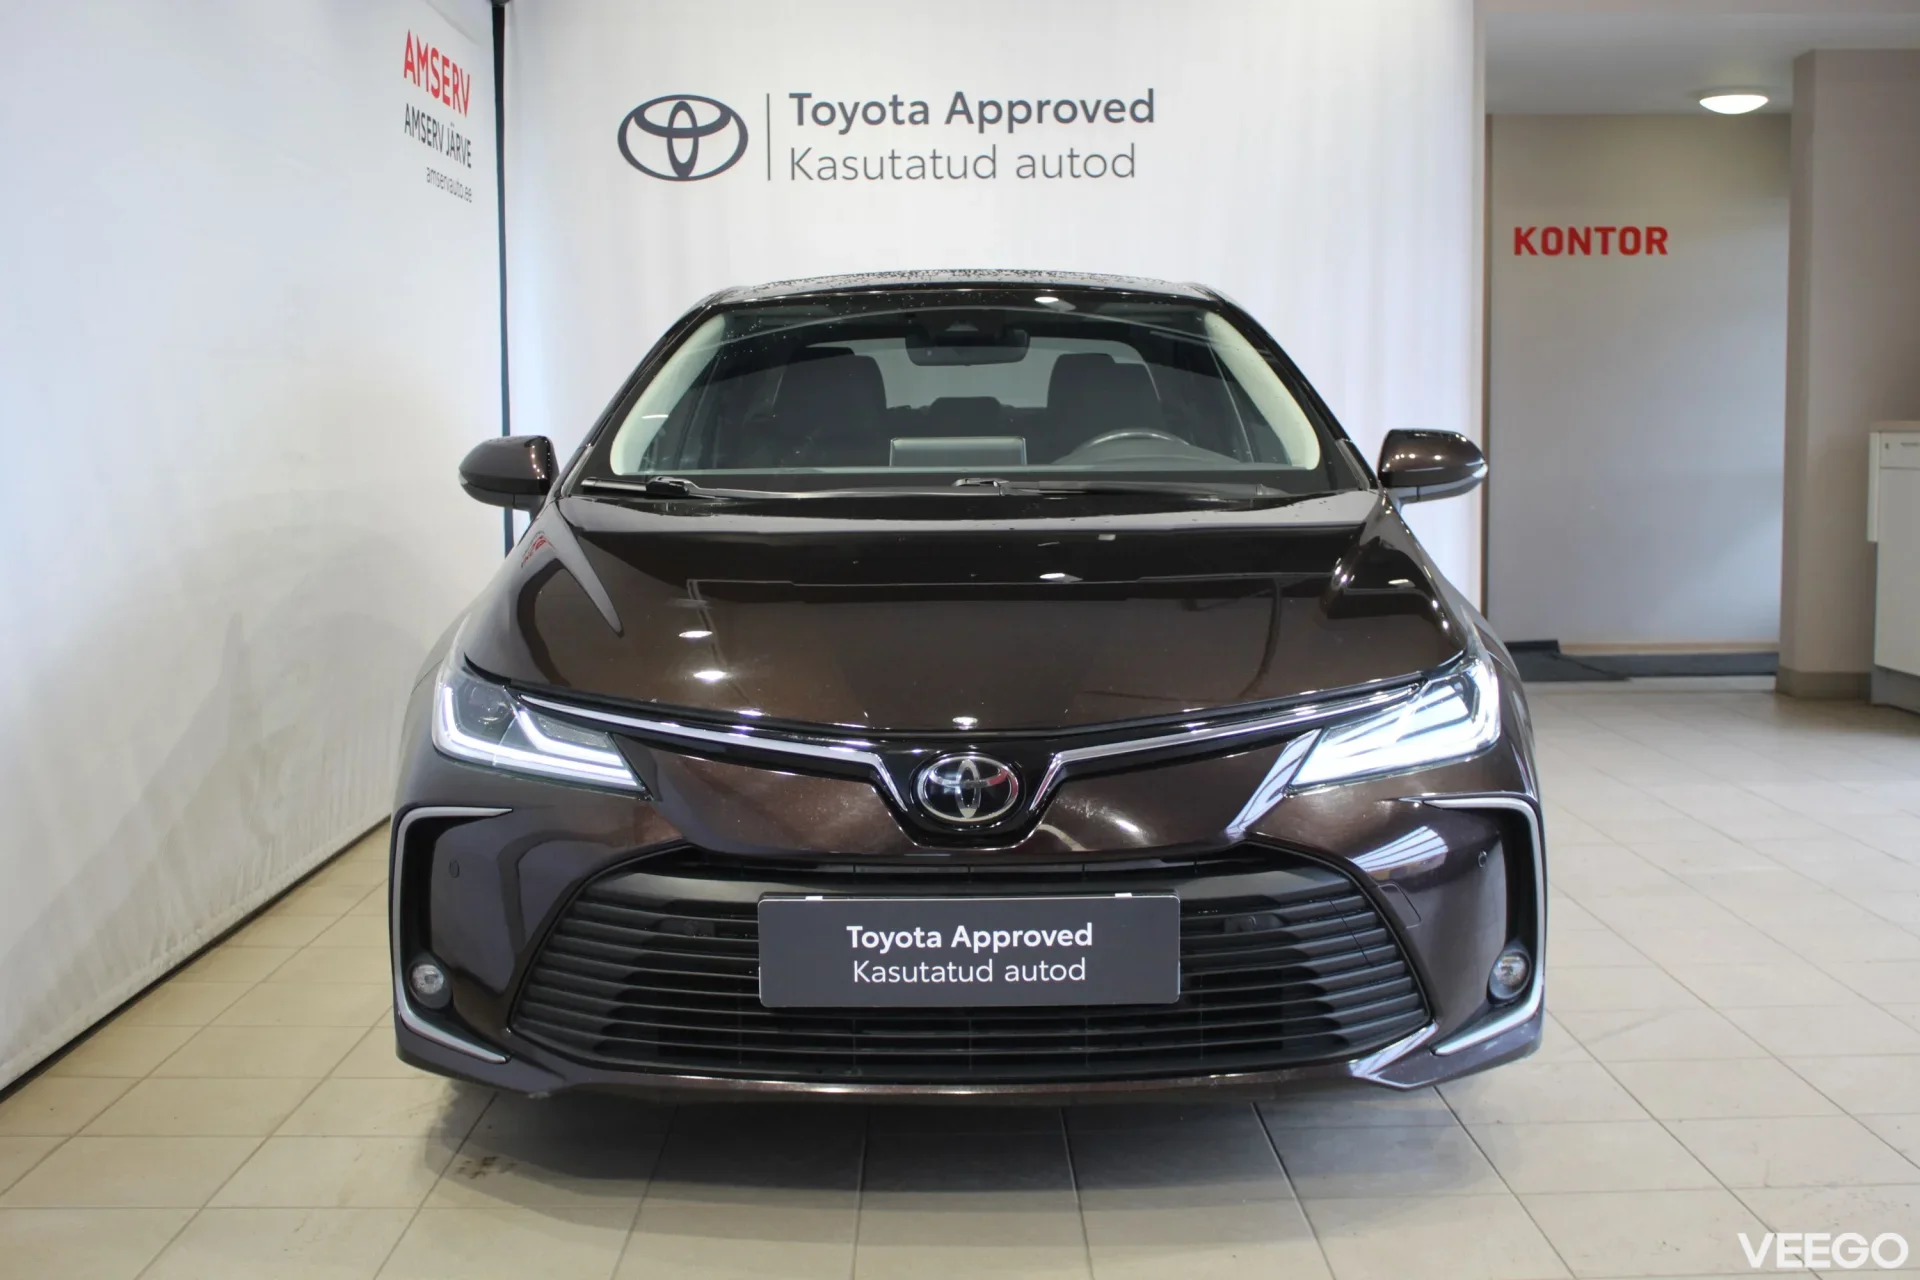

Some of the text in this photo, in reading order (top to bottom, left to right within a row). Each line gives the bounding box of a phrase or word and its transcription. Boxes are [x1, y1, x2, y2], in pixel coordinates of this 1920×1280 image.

[404, 29, 470, 118] AMSERV
[789, 88, 1156, 135] Toyota Approved
[404, 103, 472, 169] AMSERV JÄRVE
[790, 143, 1136, 181] Kasutatud autod
[426, 166, 473, 203] amservauto.ee
[1513, 226, 1669, 256] KONTOR
[846, 922, 1093, 955] Toyota Approved
[853, 957, 1087, 984] Kasutatud autod
